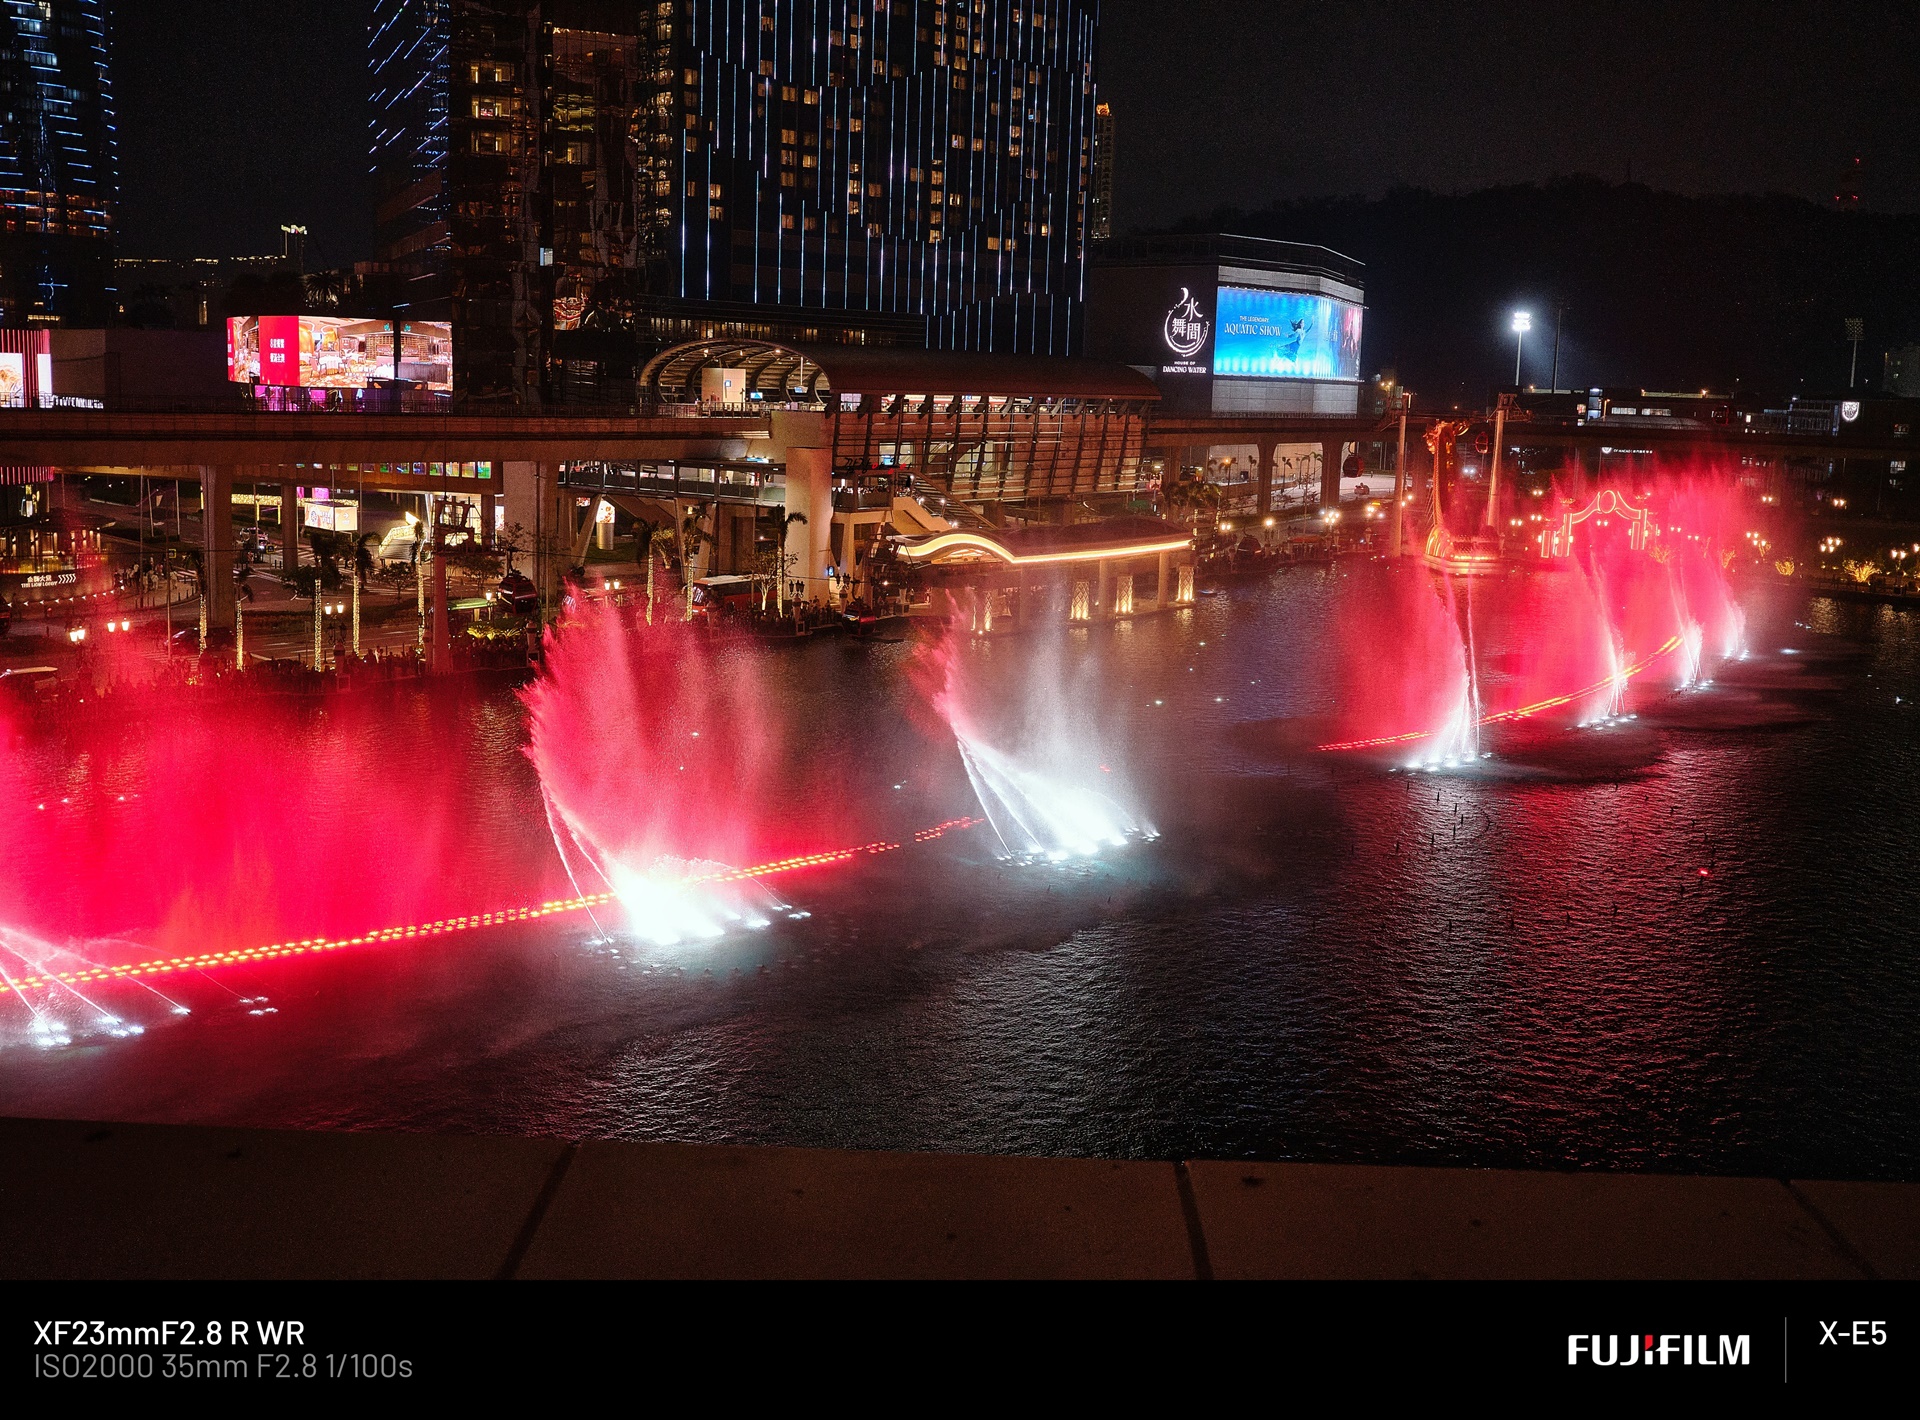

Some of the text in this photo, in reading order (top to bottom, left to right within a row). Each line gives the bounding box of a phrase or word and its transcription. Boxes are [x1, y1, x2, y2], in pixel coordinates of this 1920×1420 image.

[1224, 323, 1282, 337] AQUATIC SHOW
[1188, 366, 1207, 374] WATER
